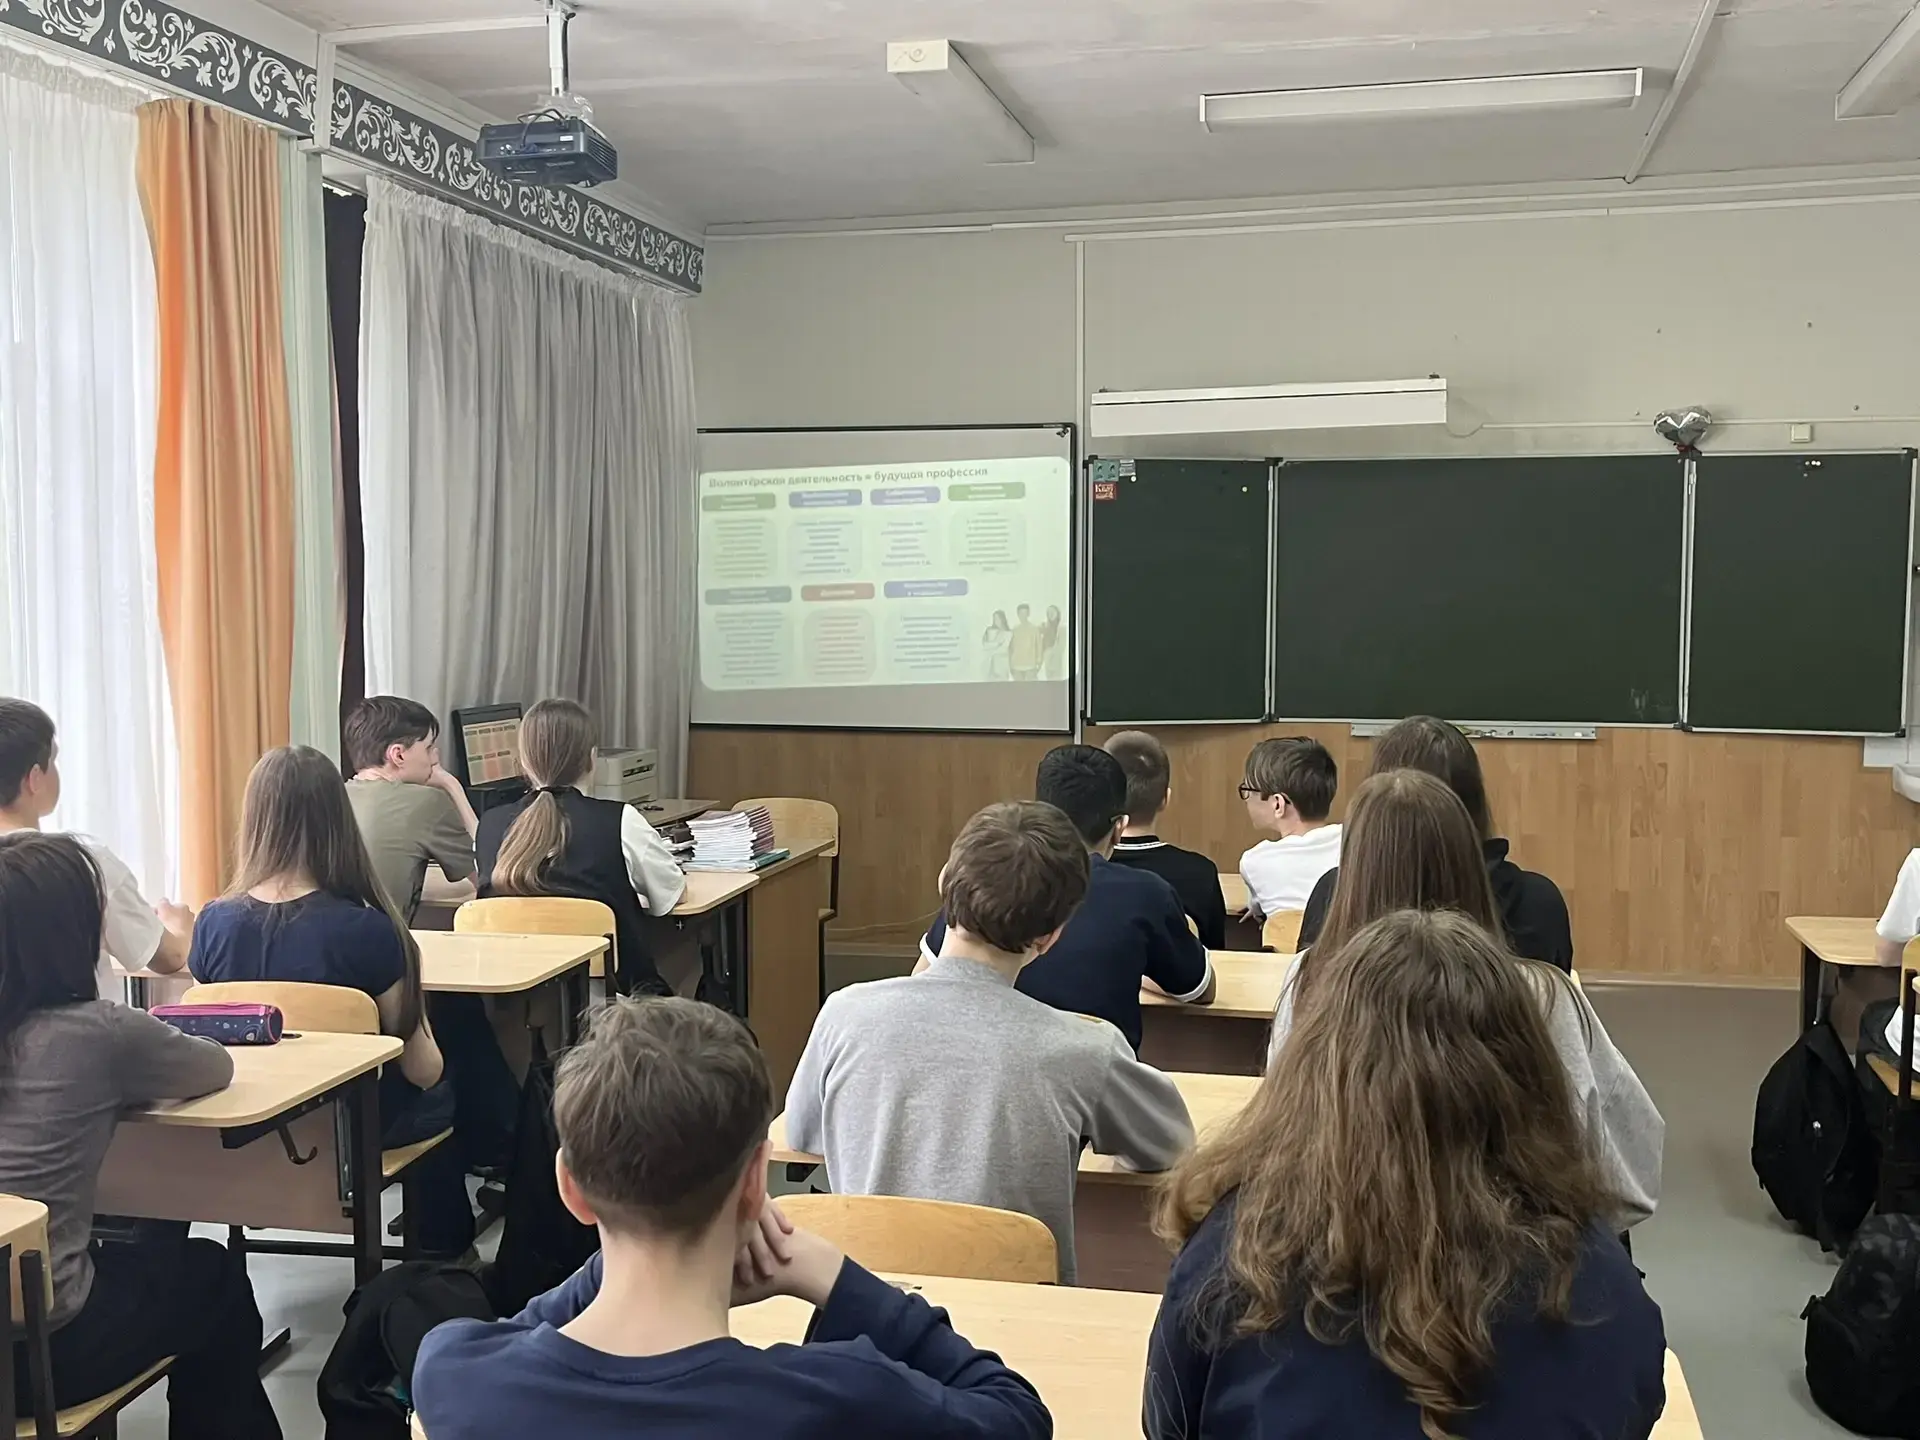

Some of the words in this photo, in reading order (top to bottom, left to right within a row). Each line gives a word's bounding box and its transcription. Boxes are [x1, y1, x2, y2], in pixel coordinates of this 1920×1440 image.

[787, 473, 862, 486] деятельность
[874, 470, 924, 483] будущая
[927, 467, 988, 480] профессия
